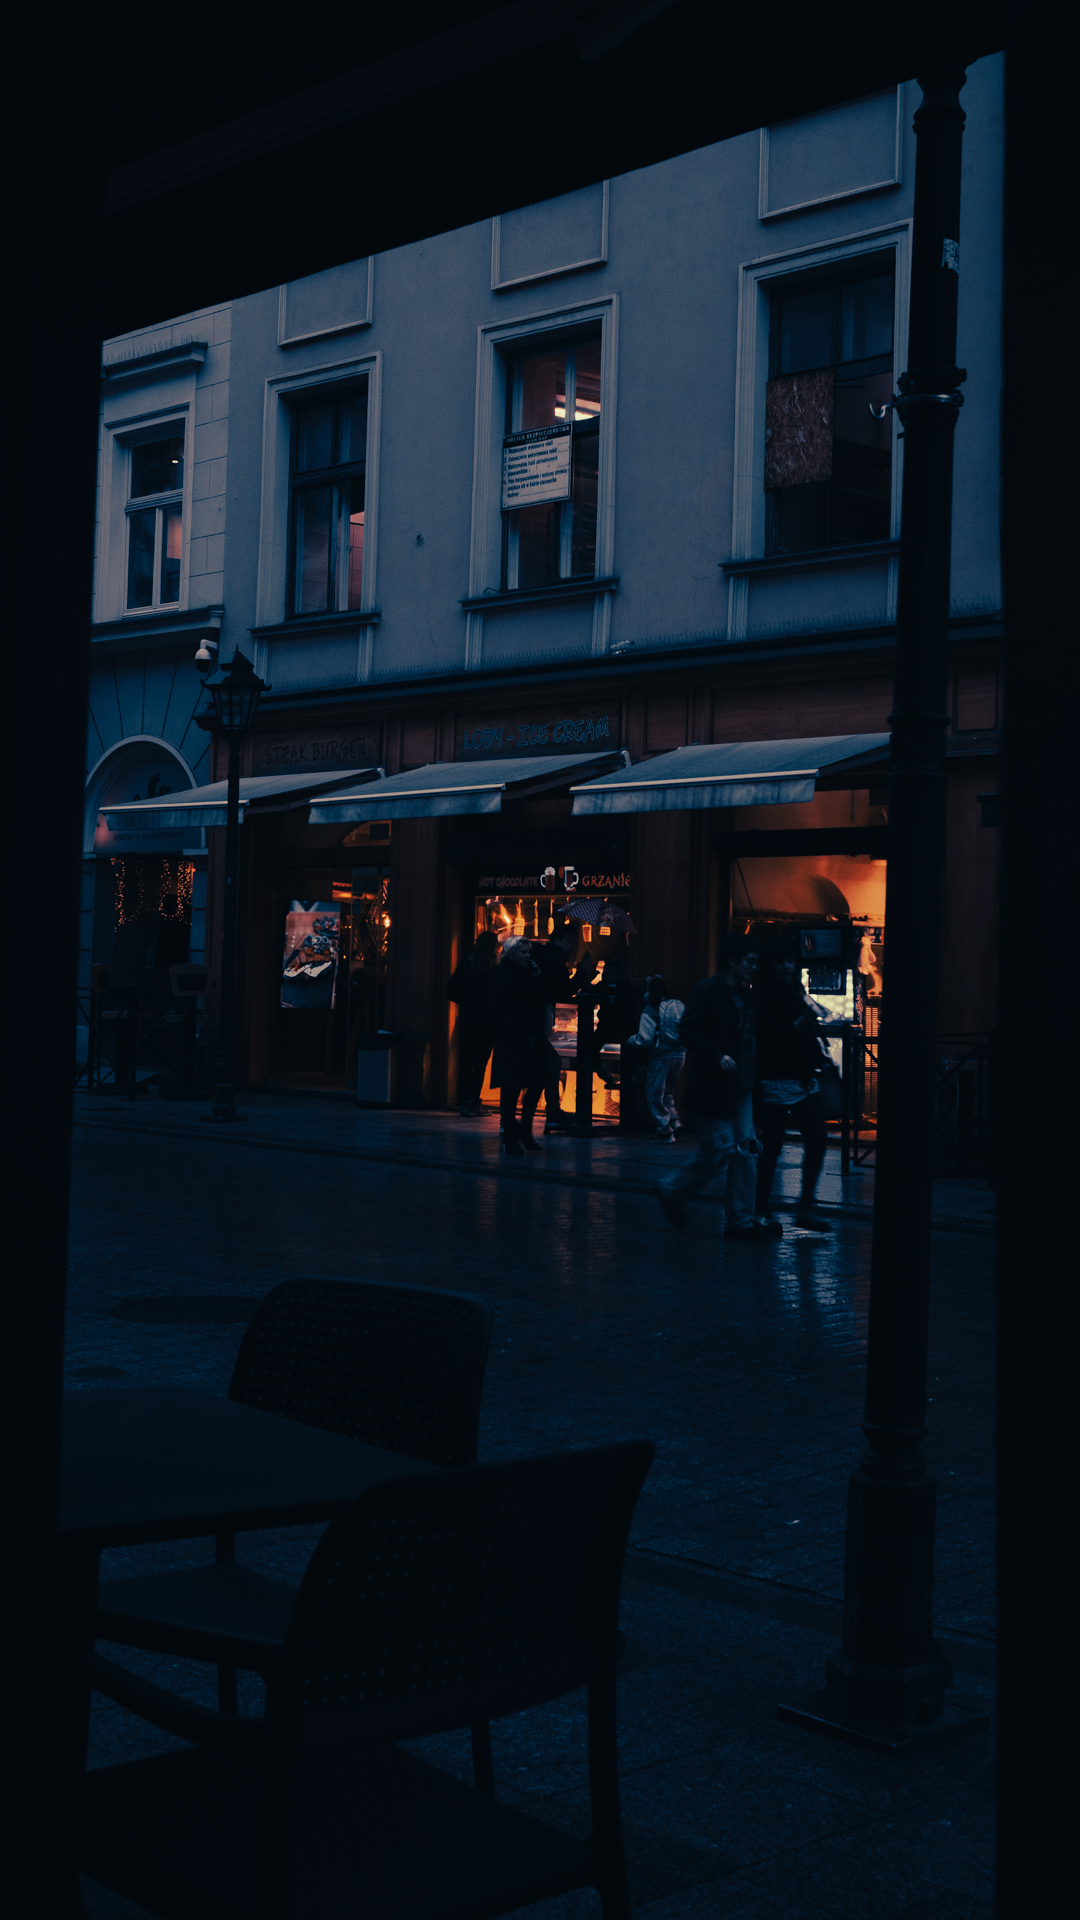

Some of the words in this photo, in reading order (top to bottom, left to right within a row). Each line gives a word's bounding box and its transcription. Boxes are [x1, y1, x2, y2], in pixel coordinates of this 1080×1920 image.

[463, 726, 504, 750] LODY
[517, 724, 548, 747] ICE
[552, 716, 609, 743] CREAM
[265, 742, 306, 765] STEAK
[310, 738, 366, 762] BURGER
[478, 875, 493, 888] HOT
[496, 875, 539, 888] CHOCOLATE
